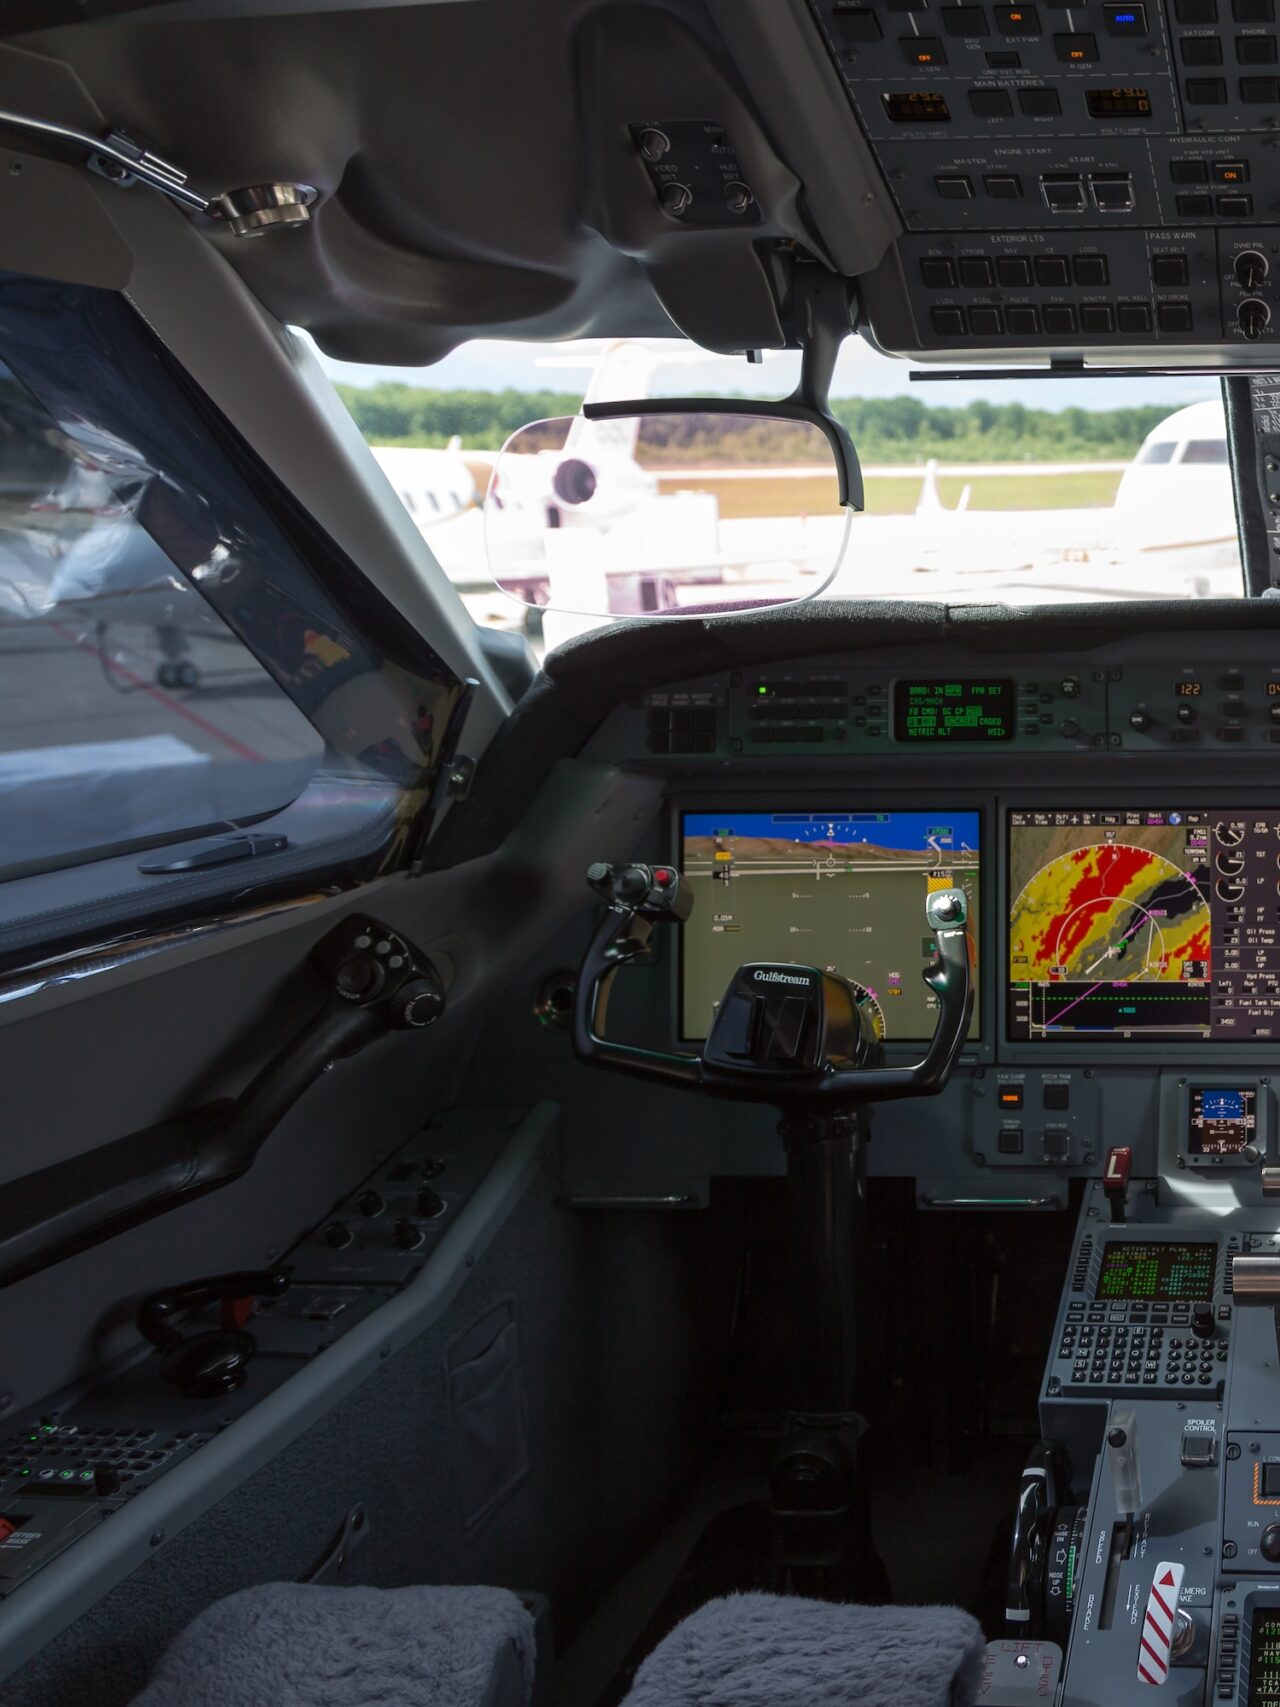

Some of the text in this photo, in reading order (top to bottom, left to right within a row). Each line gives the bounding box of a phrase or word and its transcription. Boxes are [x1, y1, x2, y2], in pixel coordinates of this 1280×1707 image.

[1115, 14, 1134, 23] AUTO
[998, 79, 1045, 87] BATTERIES
[991, 234, 1044, 243] EXTERIOR LTS
[1180, 681, 1201, 695] 122
[908, 728, 936, 736] METRIC
[753, 970, 810, 986] Gulfstream
[1106, 1155, 1122, 1179] L
[1140, 1512, 1151, 1559] RETRACT
[1095, 1530, 1106, 1564] SPEED
[1130, 1584, 1140, 1625] EXTEND
[1083, 1594, 1095, 1631] BRAKE
[1001, 1642, 1044, 1653] LIFT
